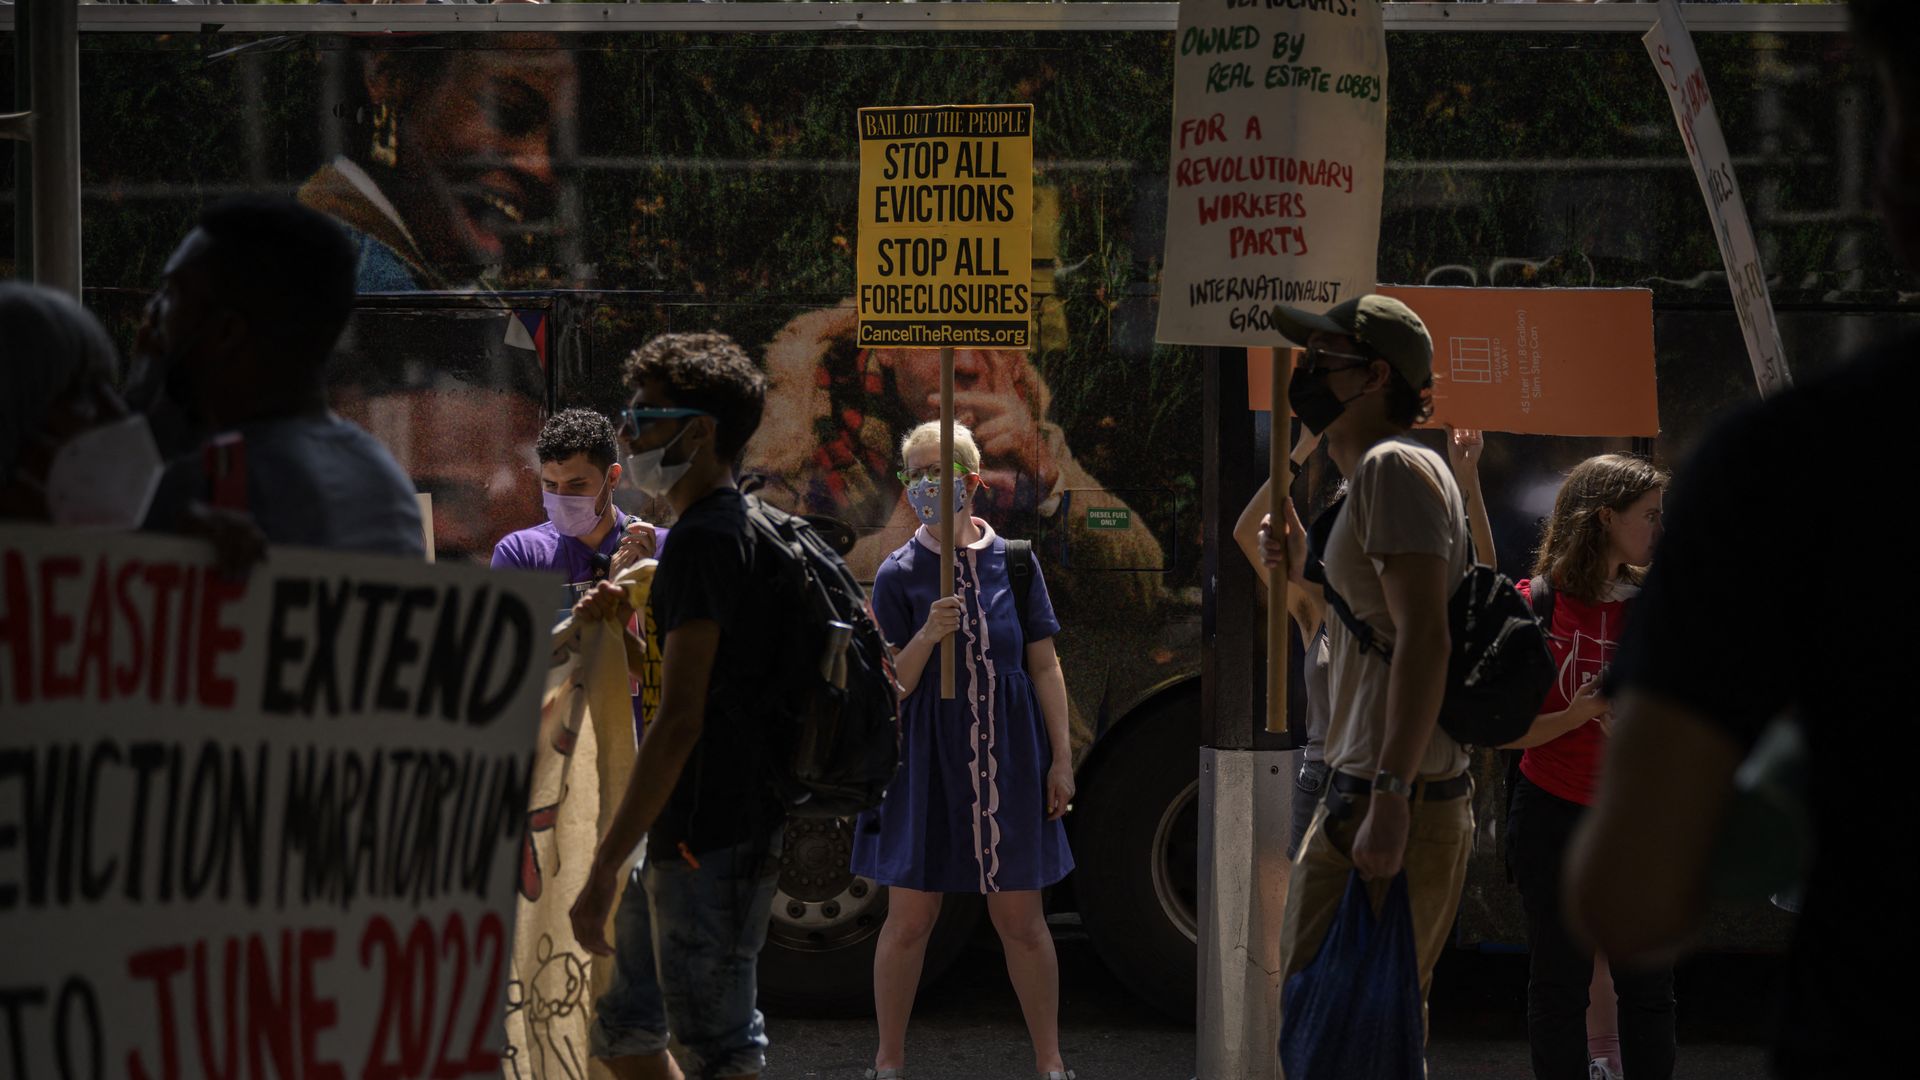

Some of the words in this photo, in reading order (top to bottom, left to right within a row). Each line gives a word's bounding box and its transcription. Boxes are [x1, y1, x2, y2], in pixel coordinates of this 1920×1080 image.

[1181, 25, 1260, 56] OWNED
[1272, 32, 1305, 62] BY
[1206, 62, 1254, 94] REAL
[1264, 65, 1332, 93] ESTATE
[1336, 74, 1381, 101] LOBBY
[865, 113, 899, 136] BAIL
[904, 112, 932, 135] OUT
[935, 111, 964, 133] THE
[968, 110, 1026, 134] PEOPLE
[1180, 113, 1228, 149] FOR
[1246, 116, 1262, 141] A
[883, 141, 949, 180] STOP
[954, 141, 1007, 178] ALL
[1177, 155, 1353, 193] REVOLUTIONARY
[875, 184, 1014, 223] EVICTIONS
[1198, 192, 1307, 225] WORKERS
[878, 238, 948, 277] STOP
[954, 237, 1009, 276] ALL
[1230, 226, 1308, 259] PARTY
[860, 284, 1028, 314] FORECLOSURES
[1190, 274, 1341, 307] INTERNATIONALIST
[861, 325, 1025, 344] CancelTheRents.org
[1529, 326, 1539, 350] Can
[1502, 348, 1510, 376] AWAY
[1531, 352, 1541, 376] Step
[1532, 378, 1541, 398] Slim
[1090, 511, 1111, 519] DIESEL
[1112, 511, 1128, 519] FUEL
[262, 574, 535, 726] EXTEND
[277, 740, 536, 911] MORATORIUM
[0, 974, 104, 1080] TO
[129, 929, 338, 1080] JUNE
[360, 912, 507, 1080] 2022
